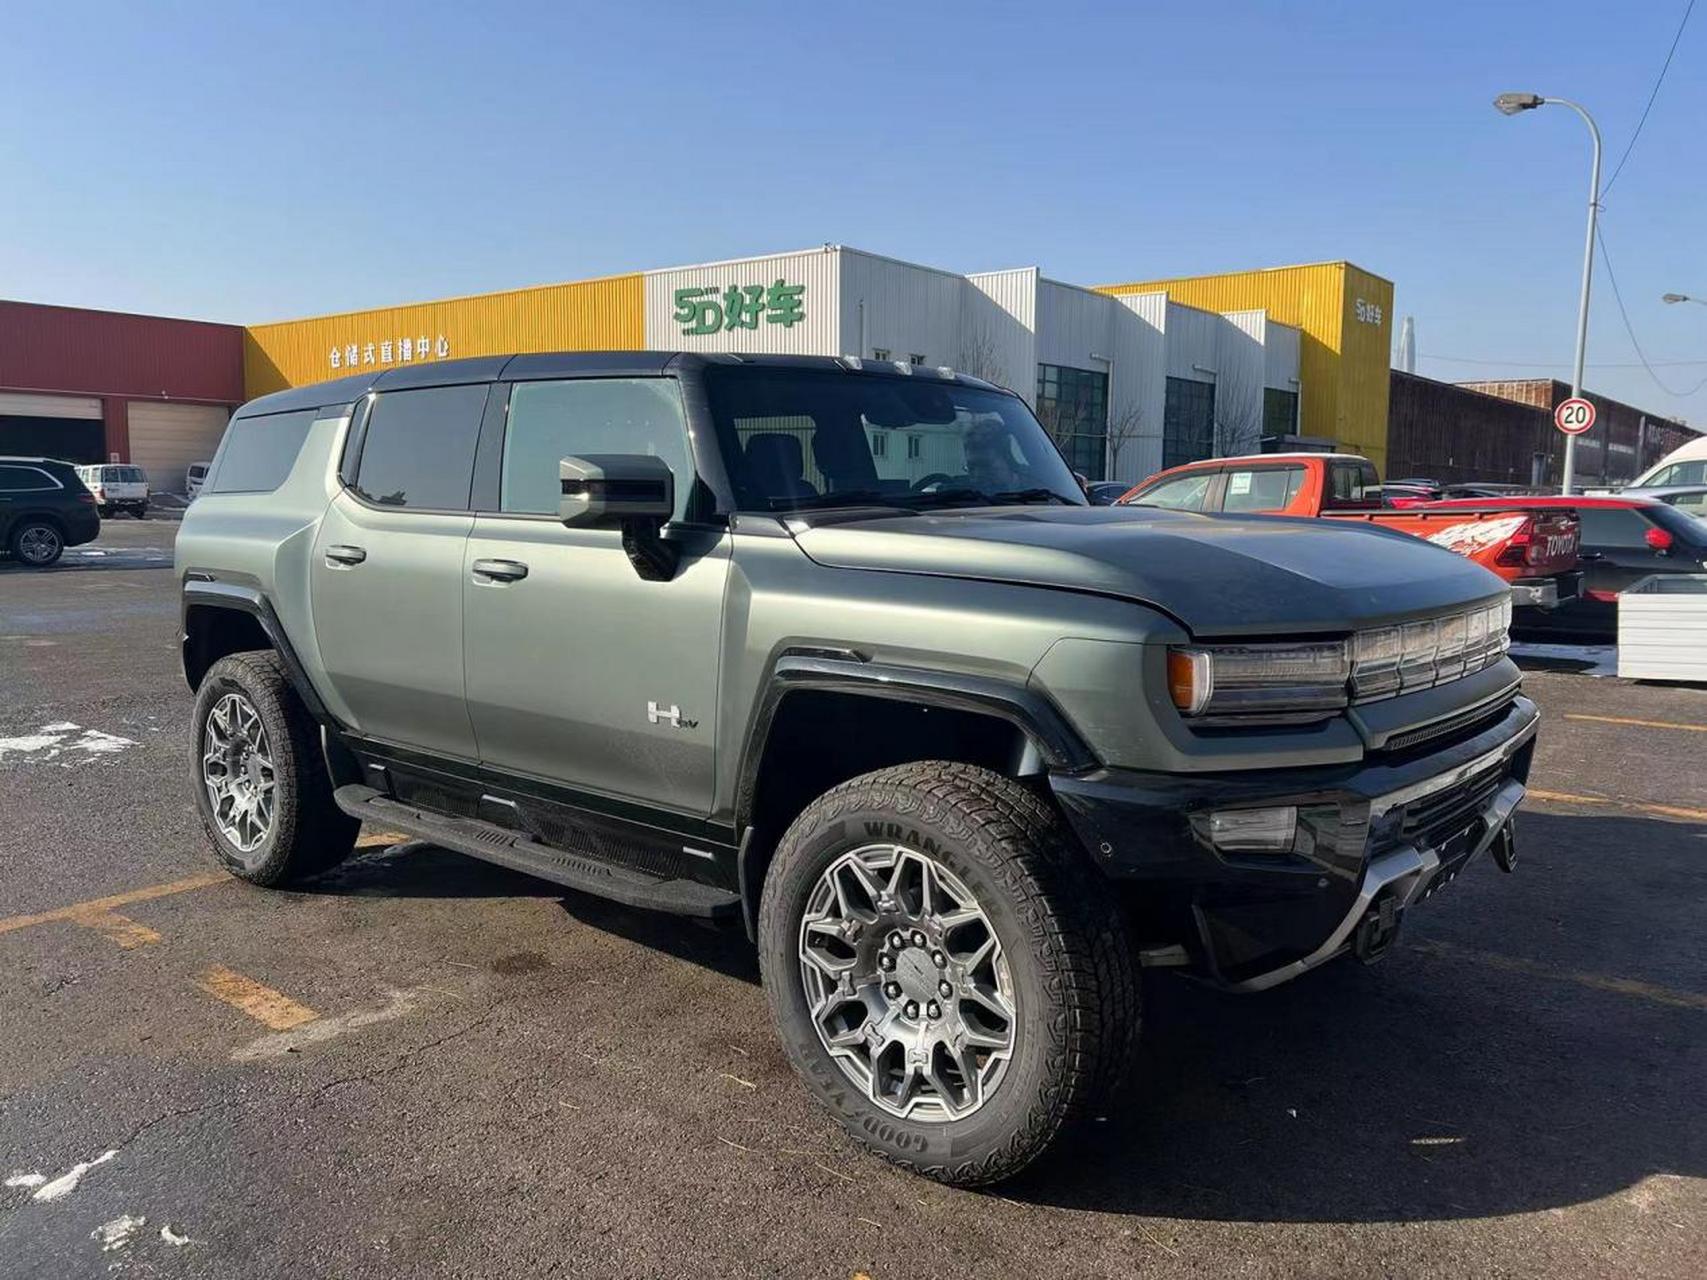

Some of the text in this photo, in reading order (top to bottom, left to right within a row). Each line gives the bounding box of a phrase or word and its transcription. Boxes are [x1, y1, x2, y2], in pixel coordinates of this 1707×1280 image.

[673, 279, 806, 335] 5D好车
[329, 334, 450, 368] 仓储式直播中心
[1564, 406, 1586, 424] 20
